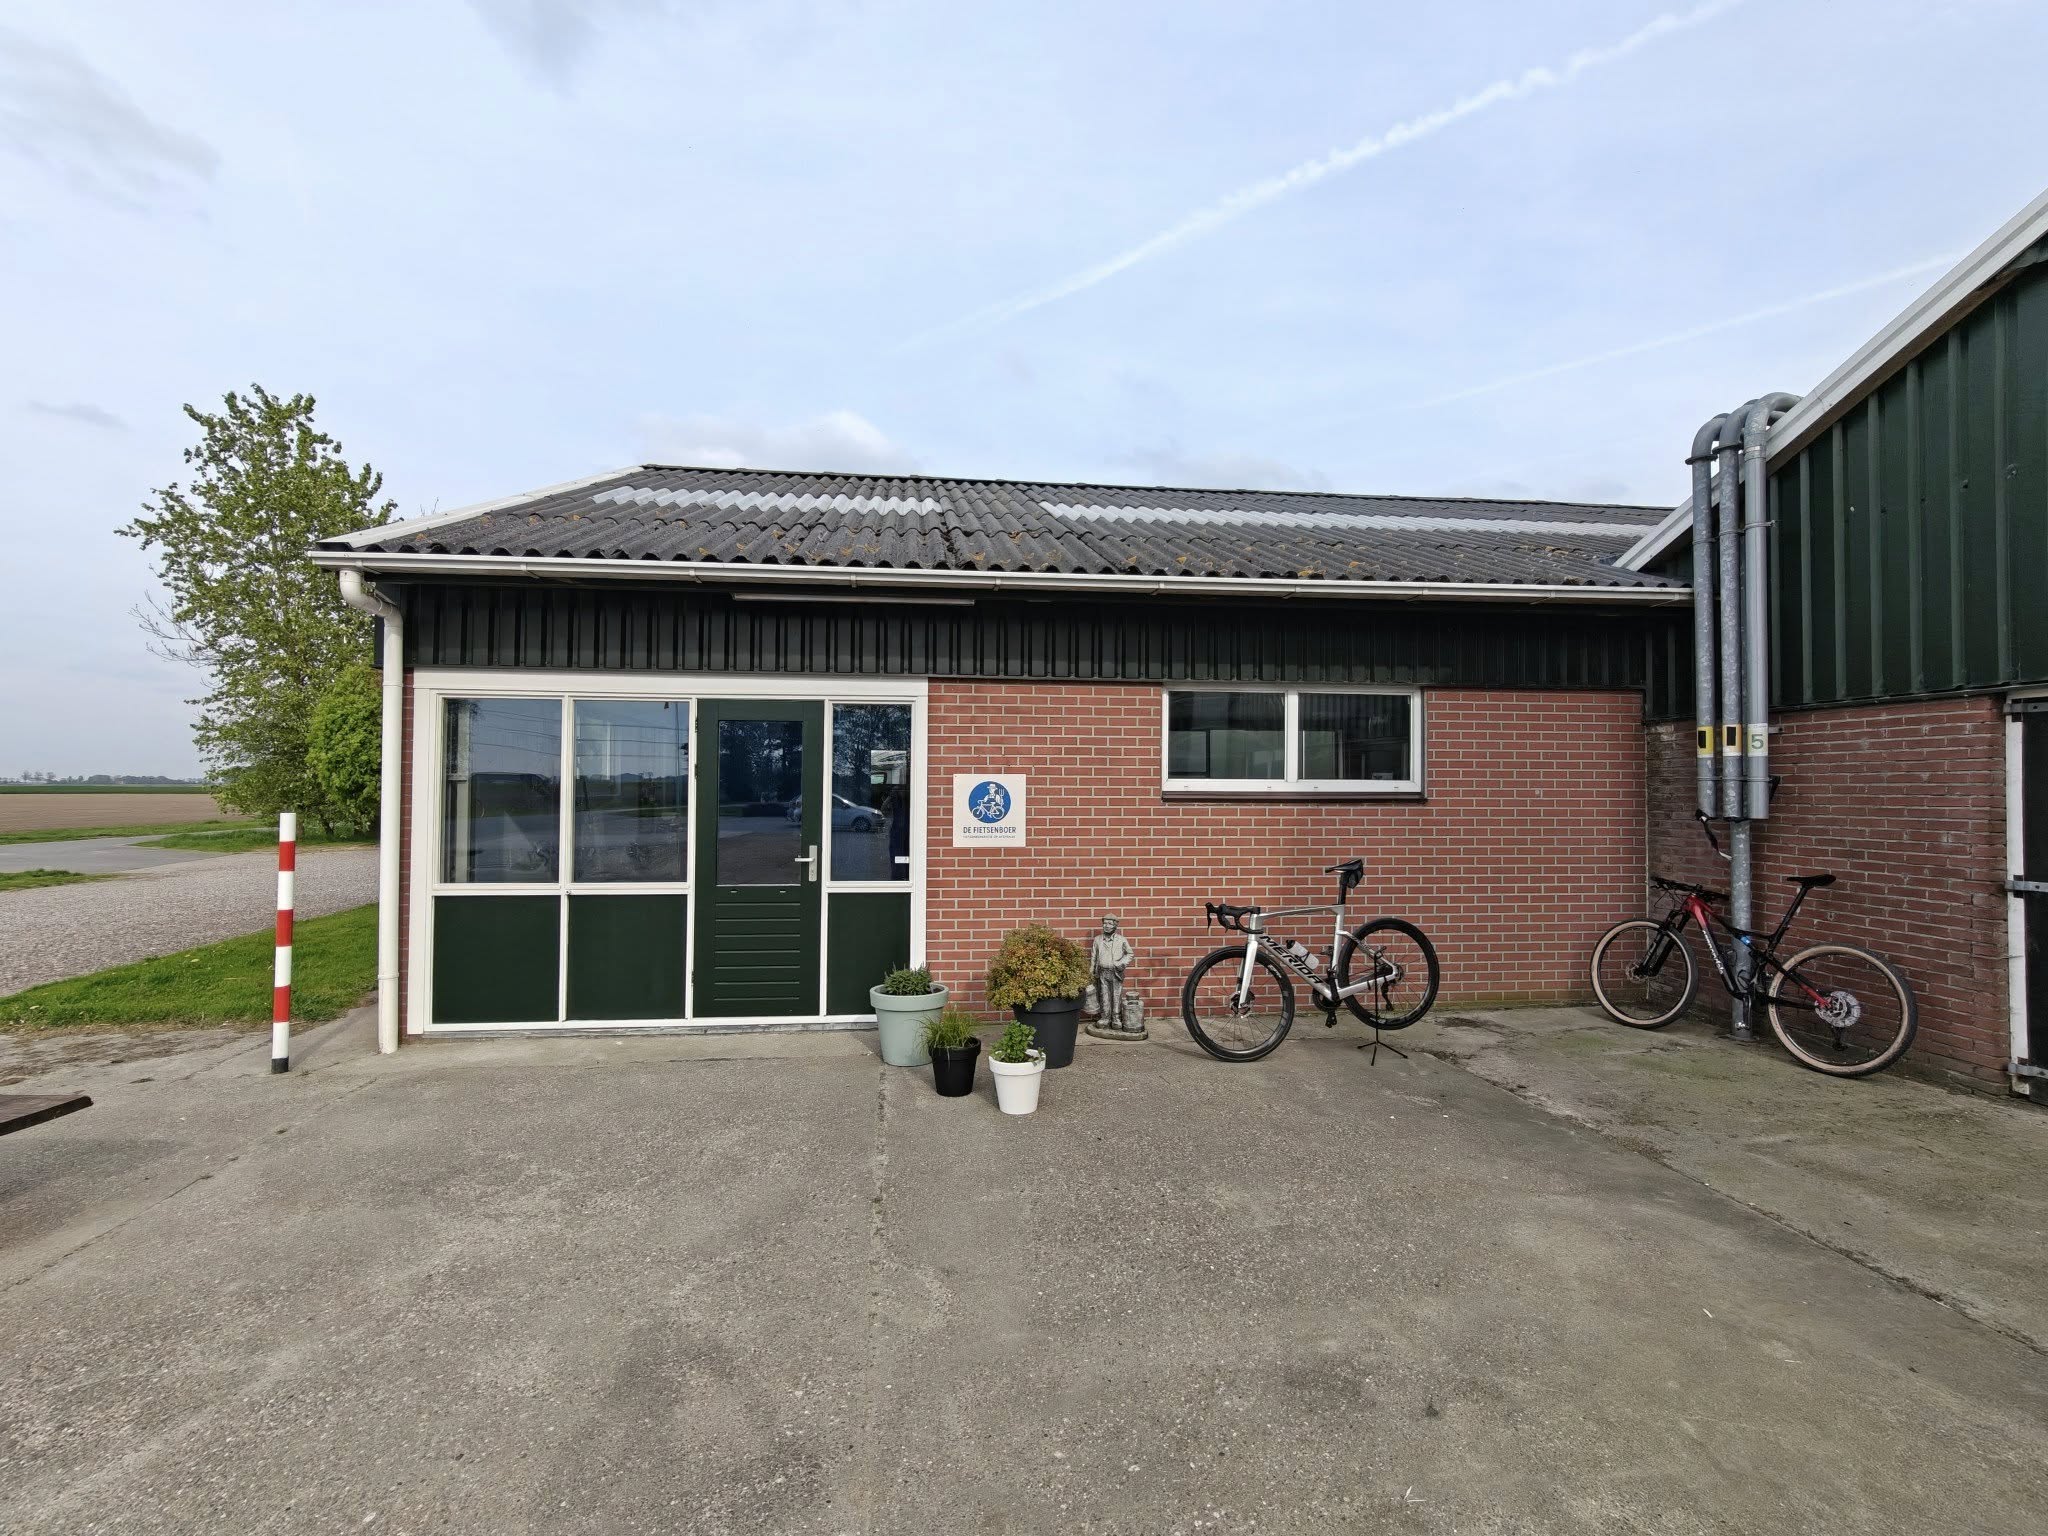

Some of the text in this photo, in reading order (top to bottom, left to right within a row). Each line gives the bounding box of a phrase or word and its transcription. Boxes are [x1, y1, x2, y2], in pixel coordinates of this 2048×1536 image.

[1751, 733, 1764, 750] 5
[963, 826, 1017, 834] DE FIETSENBOER
[1259, 935, 1324, 984] MERIDA
